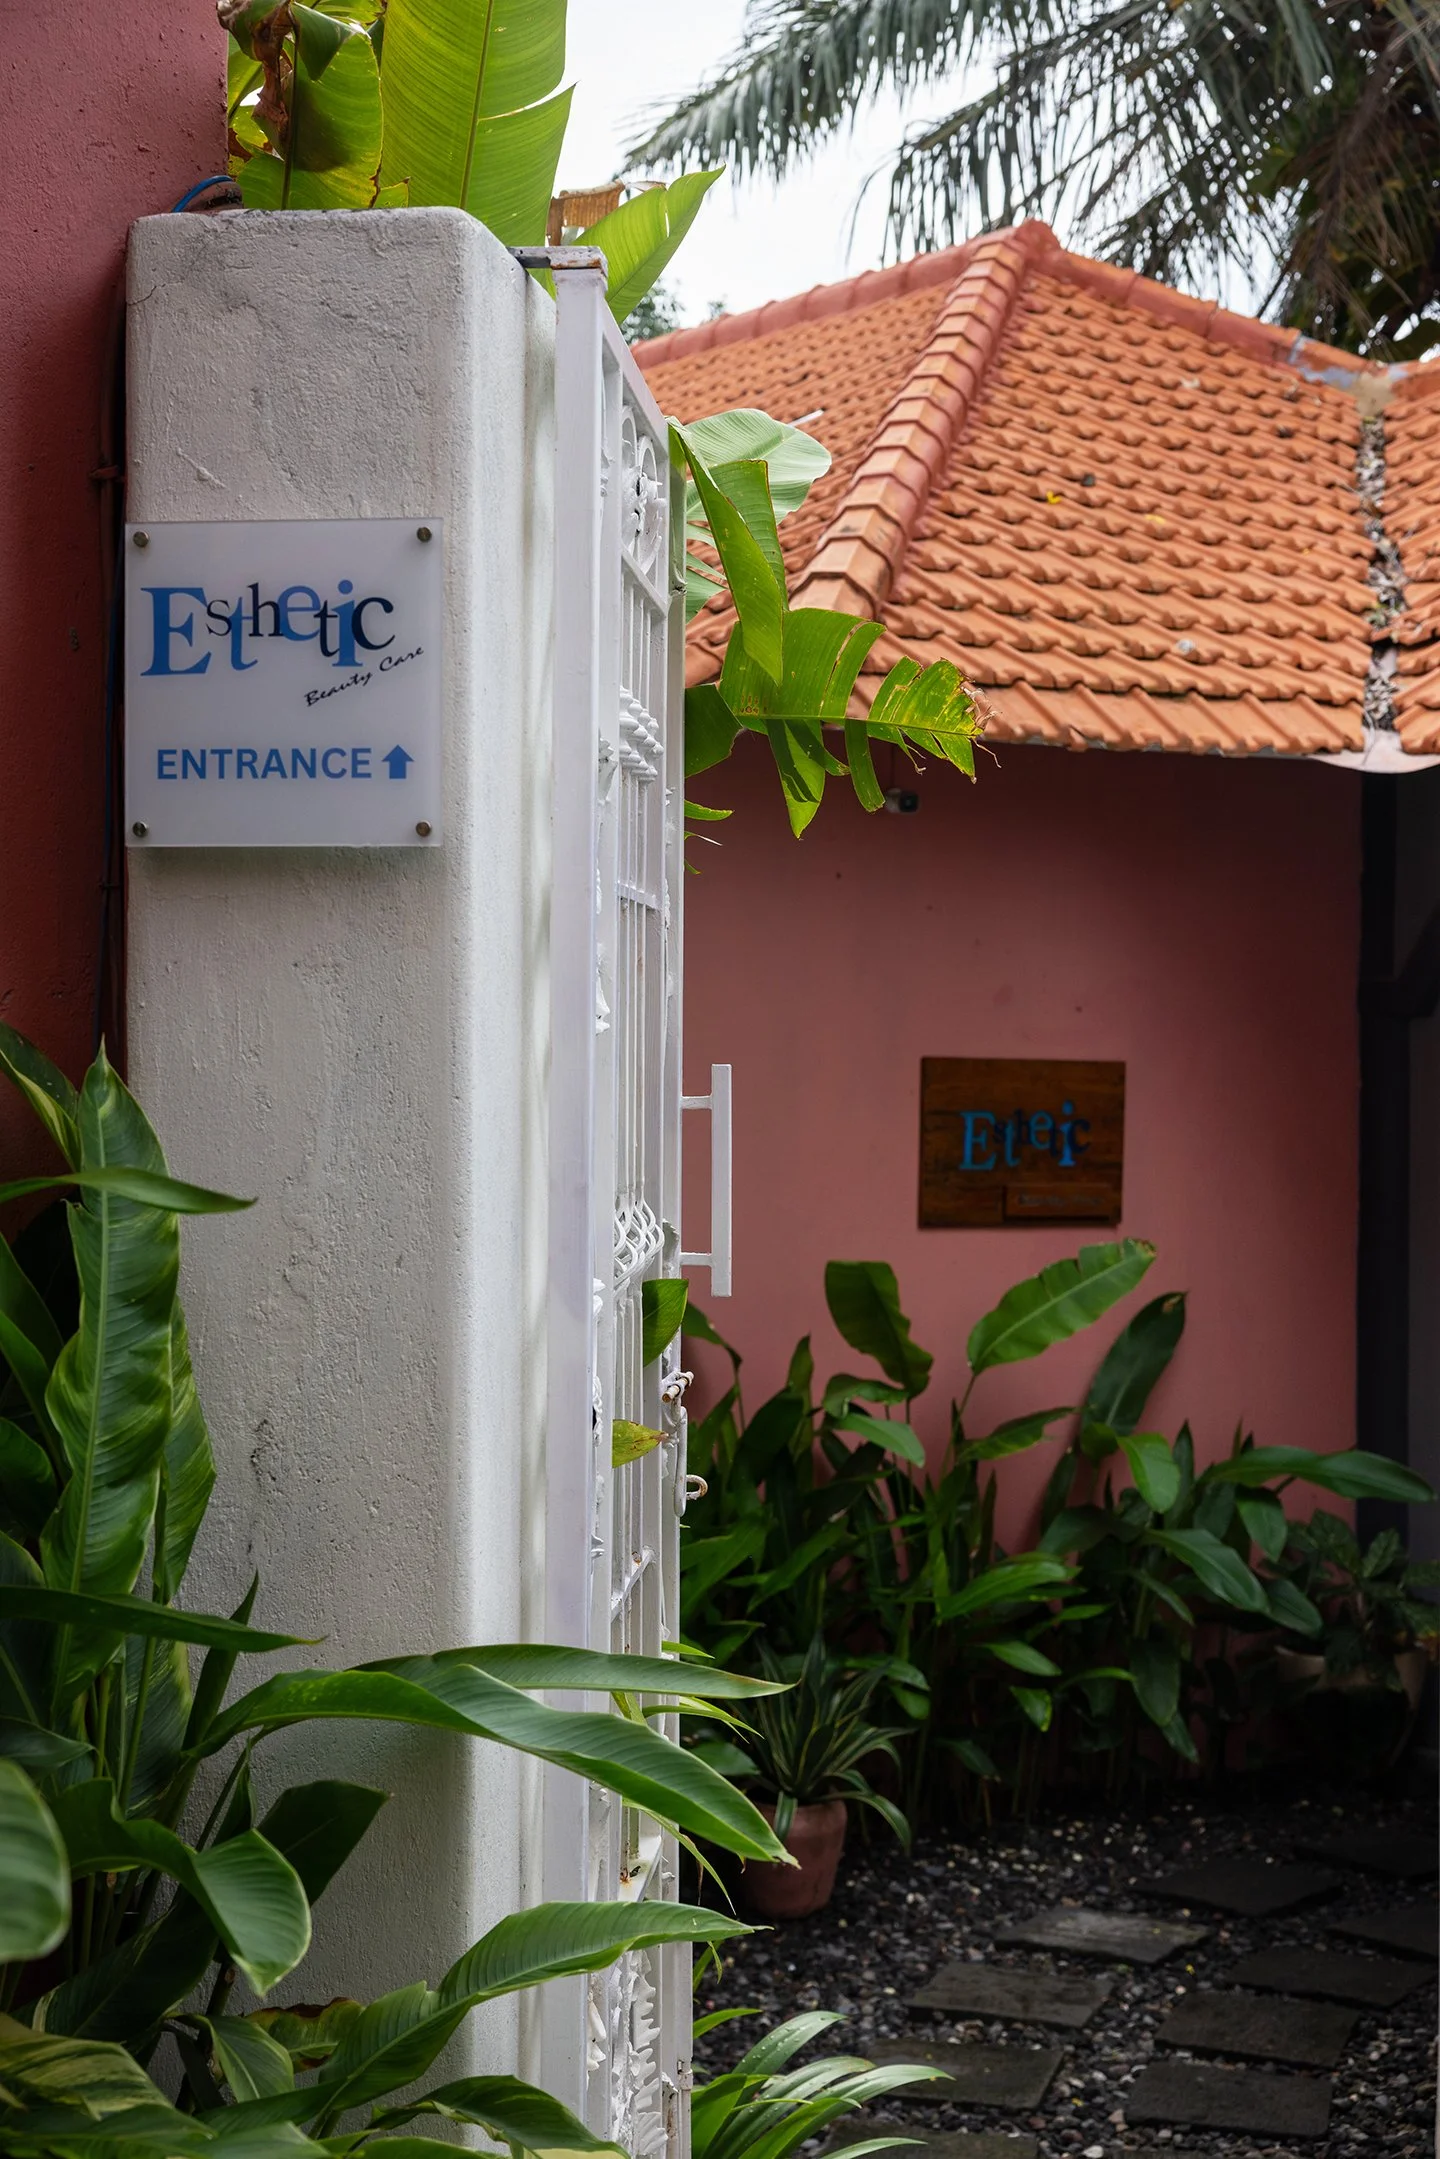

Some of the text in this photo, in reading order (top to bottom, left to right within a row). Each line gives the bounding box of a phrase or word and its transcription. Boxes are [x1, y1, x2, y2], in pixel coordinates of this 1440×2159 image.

[140, 579, 395, 677] Esthetic
[304, 646, 424, 707] Beauty Care
[157, 748, 372, 780] ENTRANCE
